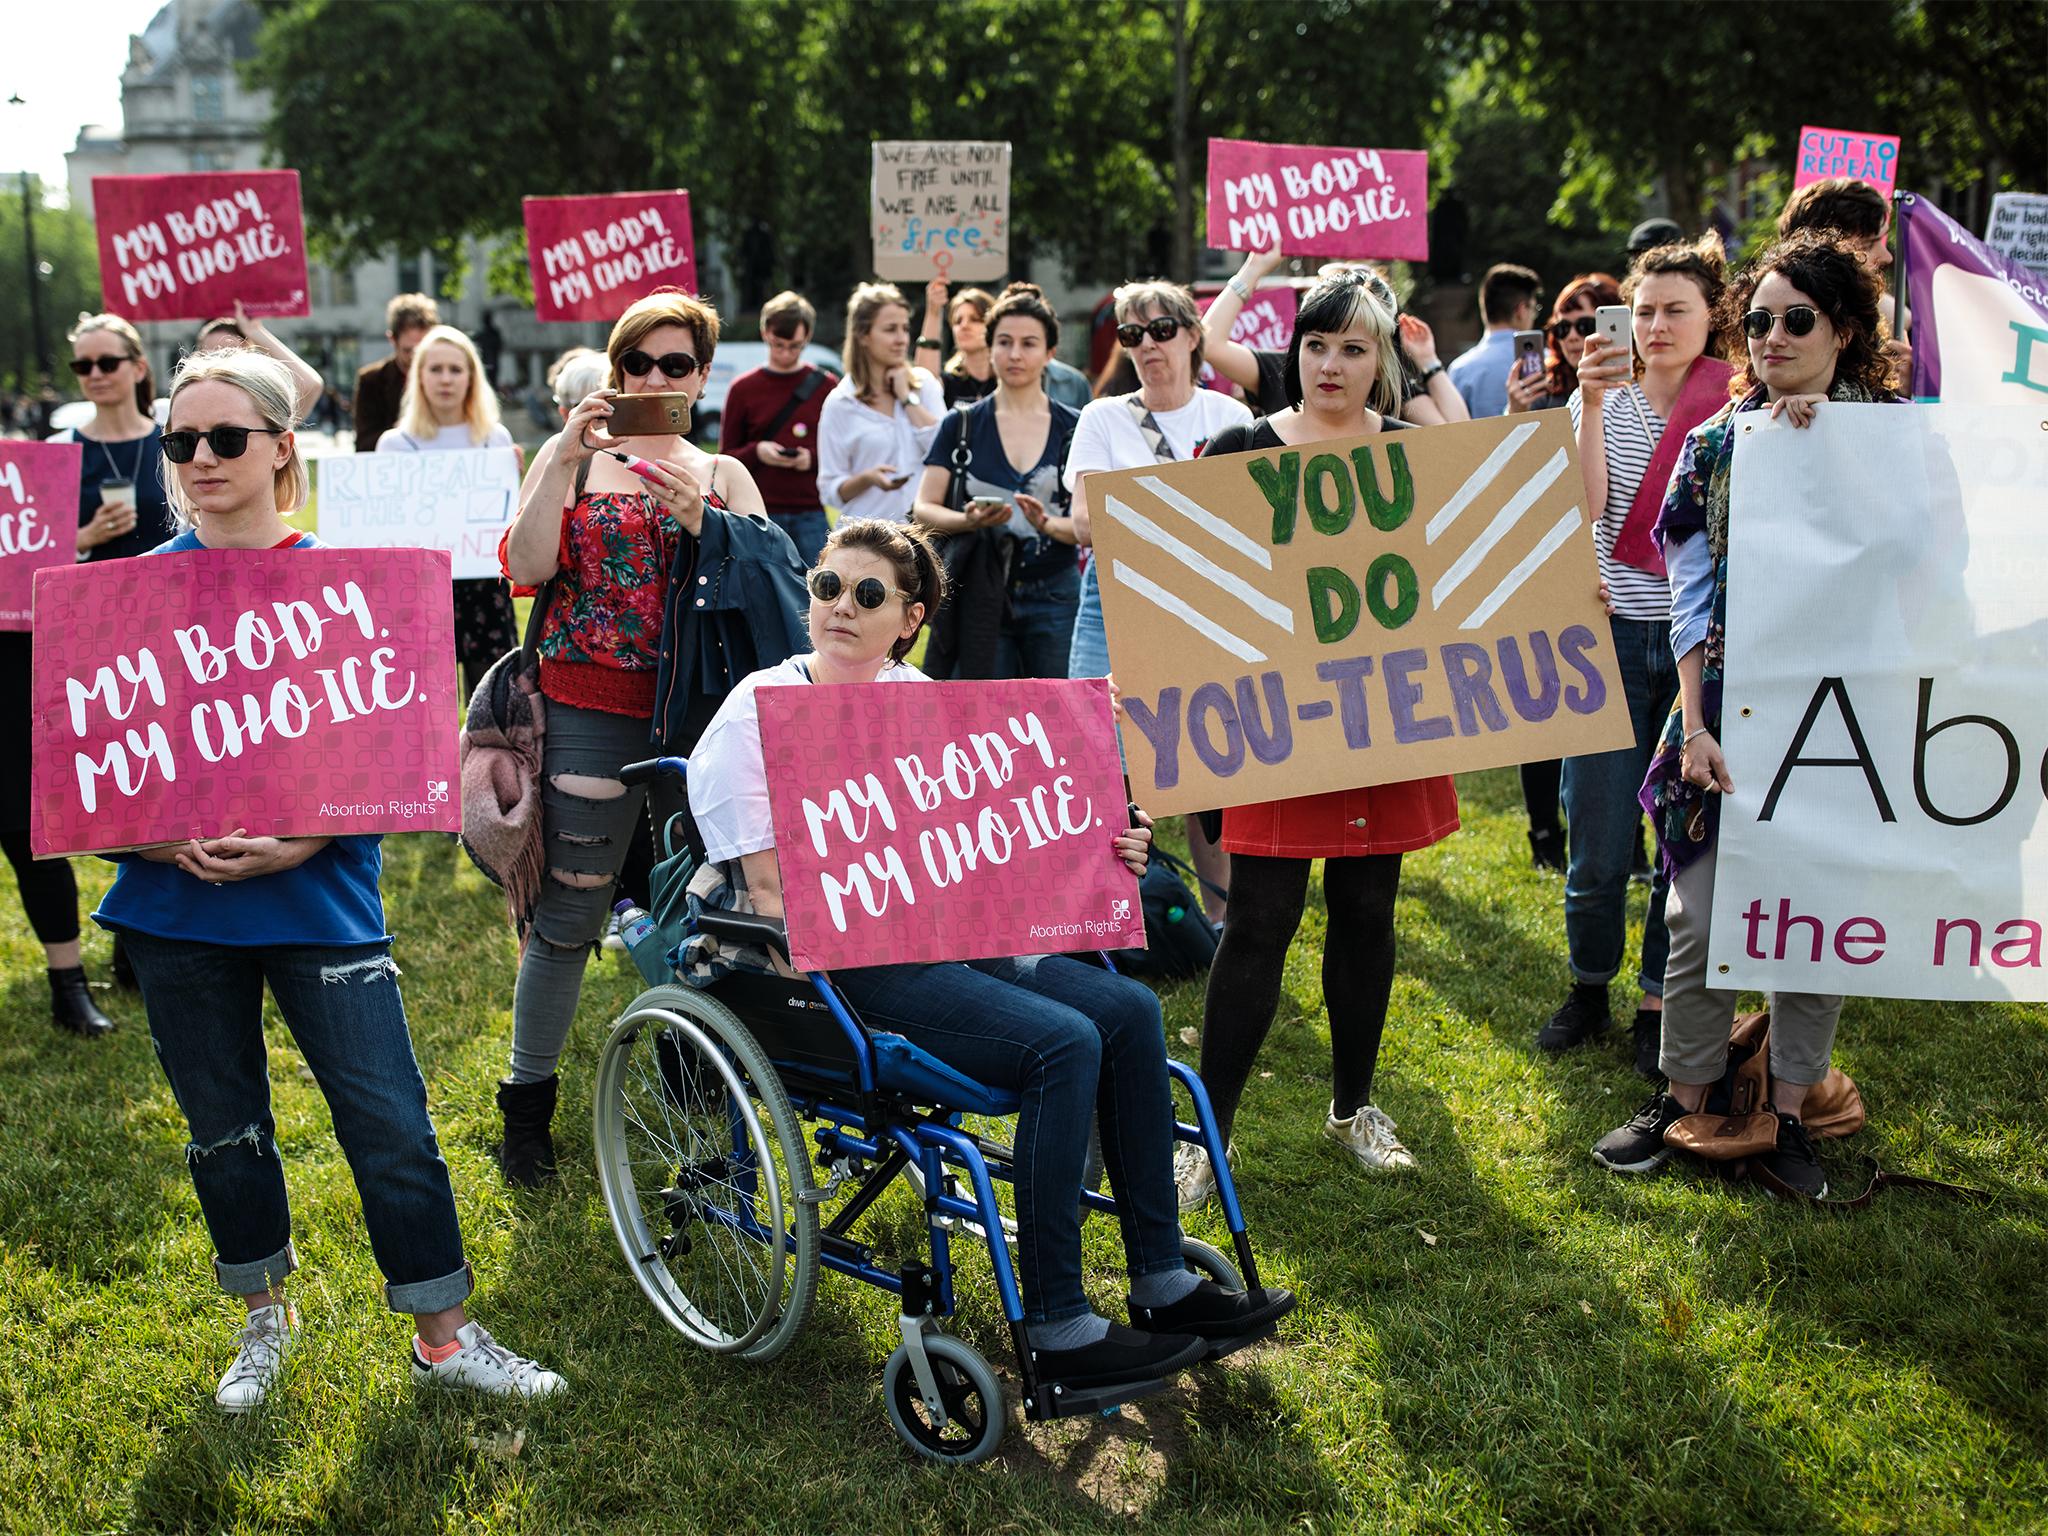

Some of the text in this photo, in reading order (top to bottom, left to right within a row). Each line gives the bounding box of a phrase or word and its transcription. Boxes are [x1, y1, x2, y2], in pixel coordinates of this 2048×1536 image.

[880, 145, 1002, 166] WE ARE NOT
[1802, 154, 1891, 182] REPEAL
[1803, 132, 1896, 160] CUT TO
[880, 195, 1002, 216] WE ARE ALL
[896, 167, 999, 192] FREE UNTIL
[1224, 149, 1393, 214] MY BODY.
[112, 188, 271, 268] MY BODY.
[542, 207, 671, 277] MY BODY.
[902, 217, 981, 251] free
[1228, 184, 1411, 249] MY CHOICE.
[1993, 226, 2015, 241] Our
[1997, 207, 2017, 223] Our
[120, 223, 291, 306] MY CHOICE.
[549, 236, 689, 309] MY CHOICE.
[325, 452, 501, 501] REPEAL
[1247, 441, 1415, 545] YOU
[324, 498, 406, 528] THE
[1306, 553, 1420, 644] DO
[65, 581, 390, 737] MY BODY.
[75, 646, 427, 814] MY CHOICE.
[1120, 624, 1607, 790] YOU-TERUS
[1756, 676, 2048, 826] Ab
[319, 801, 436, 818] Abortion Rights
[801, 711, 1067, 858] MY BODY.
[820, 775, 1103, 933] MY CHOICE.
[1029, 920, 1121, 938] Abortion Rights
[1741, 898, 2041, 968] the na
